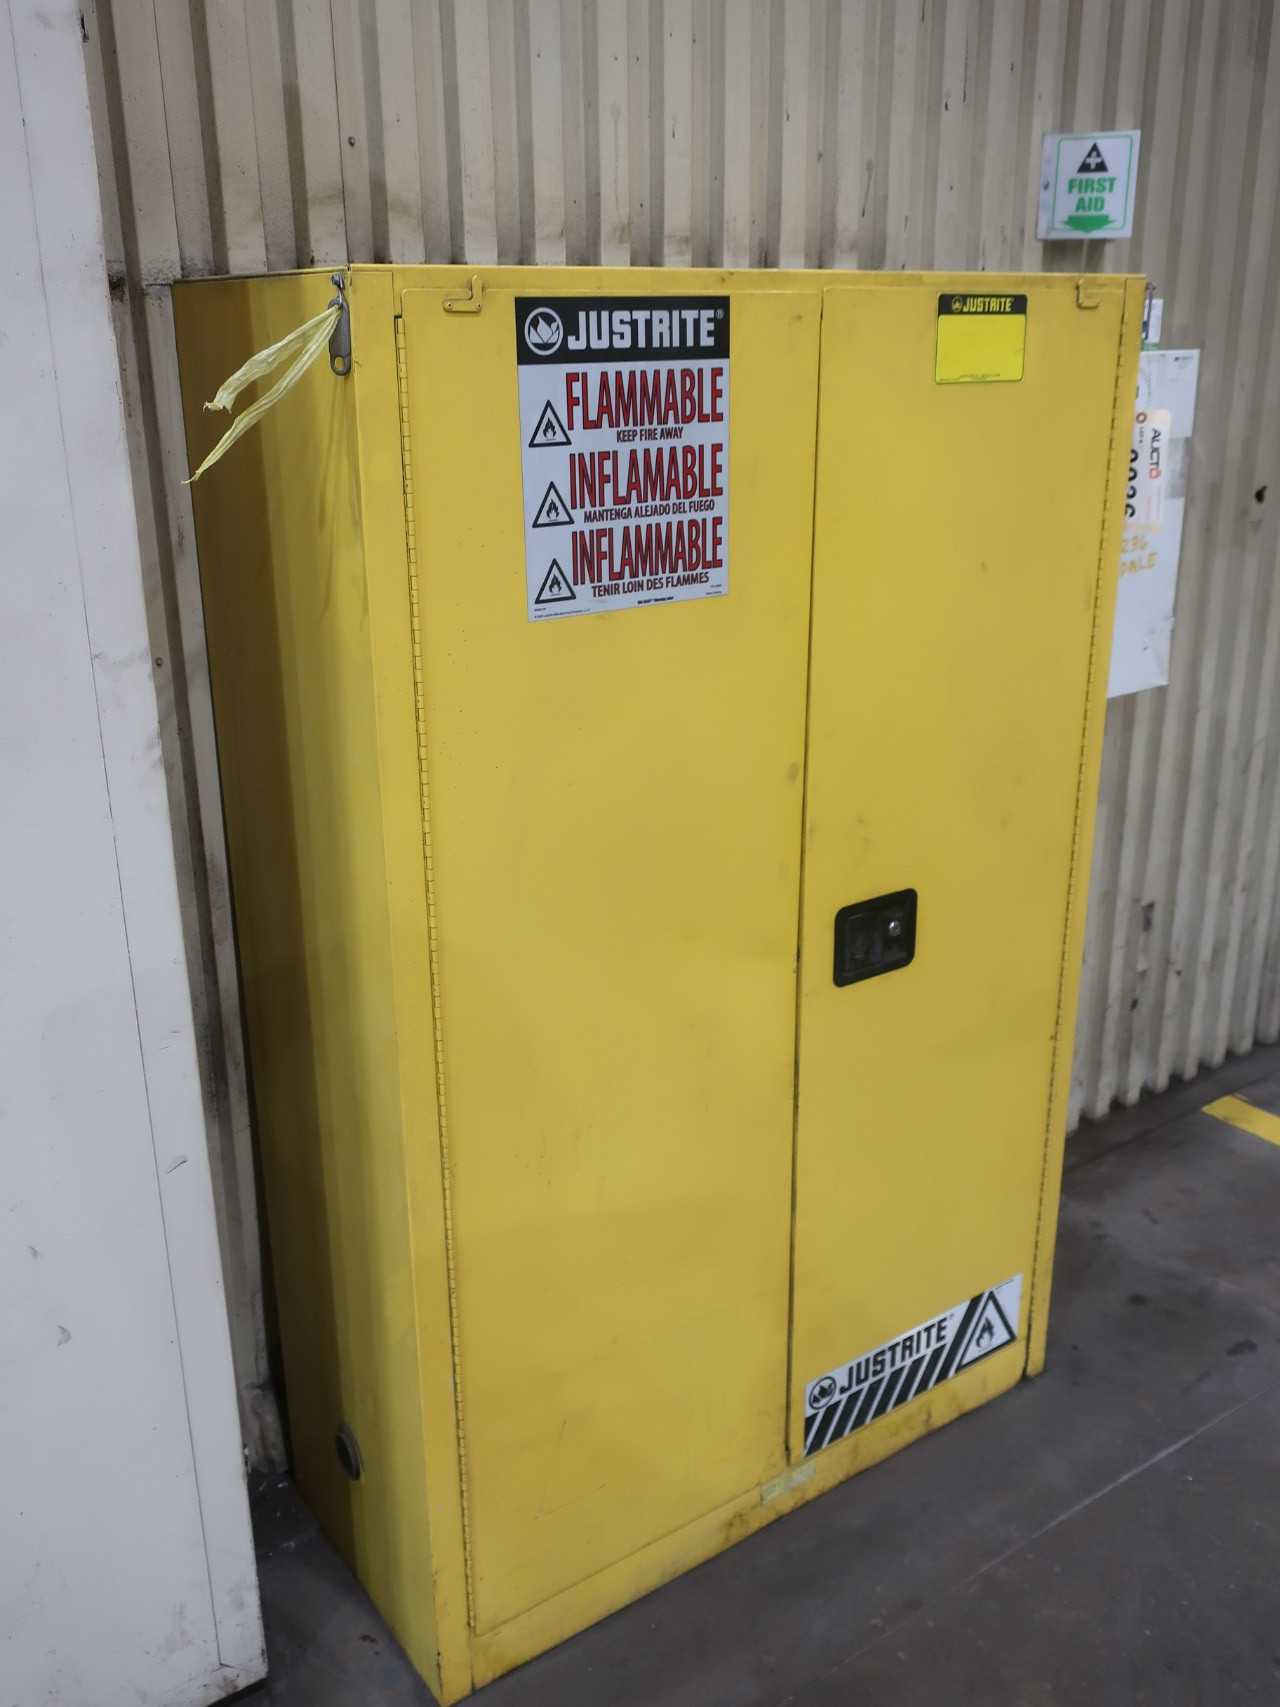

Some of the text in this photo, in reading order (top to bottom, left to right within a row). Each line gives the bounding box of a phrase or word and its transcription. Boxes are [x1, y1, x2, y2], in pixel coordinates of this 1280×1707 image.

[1068, 177, 1117, 194] FIRST
[1074, 195, 1106, 212] AID
[963, 297, 1012, 312] JUSTRITE
[567, 309, 715, 350] JUSTRITE
[565, 367, 724, 431] FLAMMABLE
[616, 427, 684, 443] KEEP FIRE AWAY
[569, 443, 724, 510] INFLAMABLE
[584, 499, 715, 523] MANTENGA ALEJADO DEL FUEGO
[571, 516, 723, 586] INFLAMMABLE
[592, 572, 710, 598] TENIR LOIN DES FLAMMES
[838, 1316, 948, 1395] JUSTRITE
